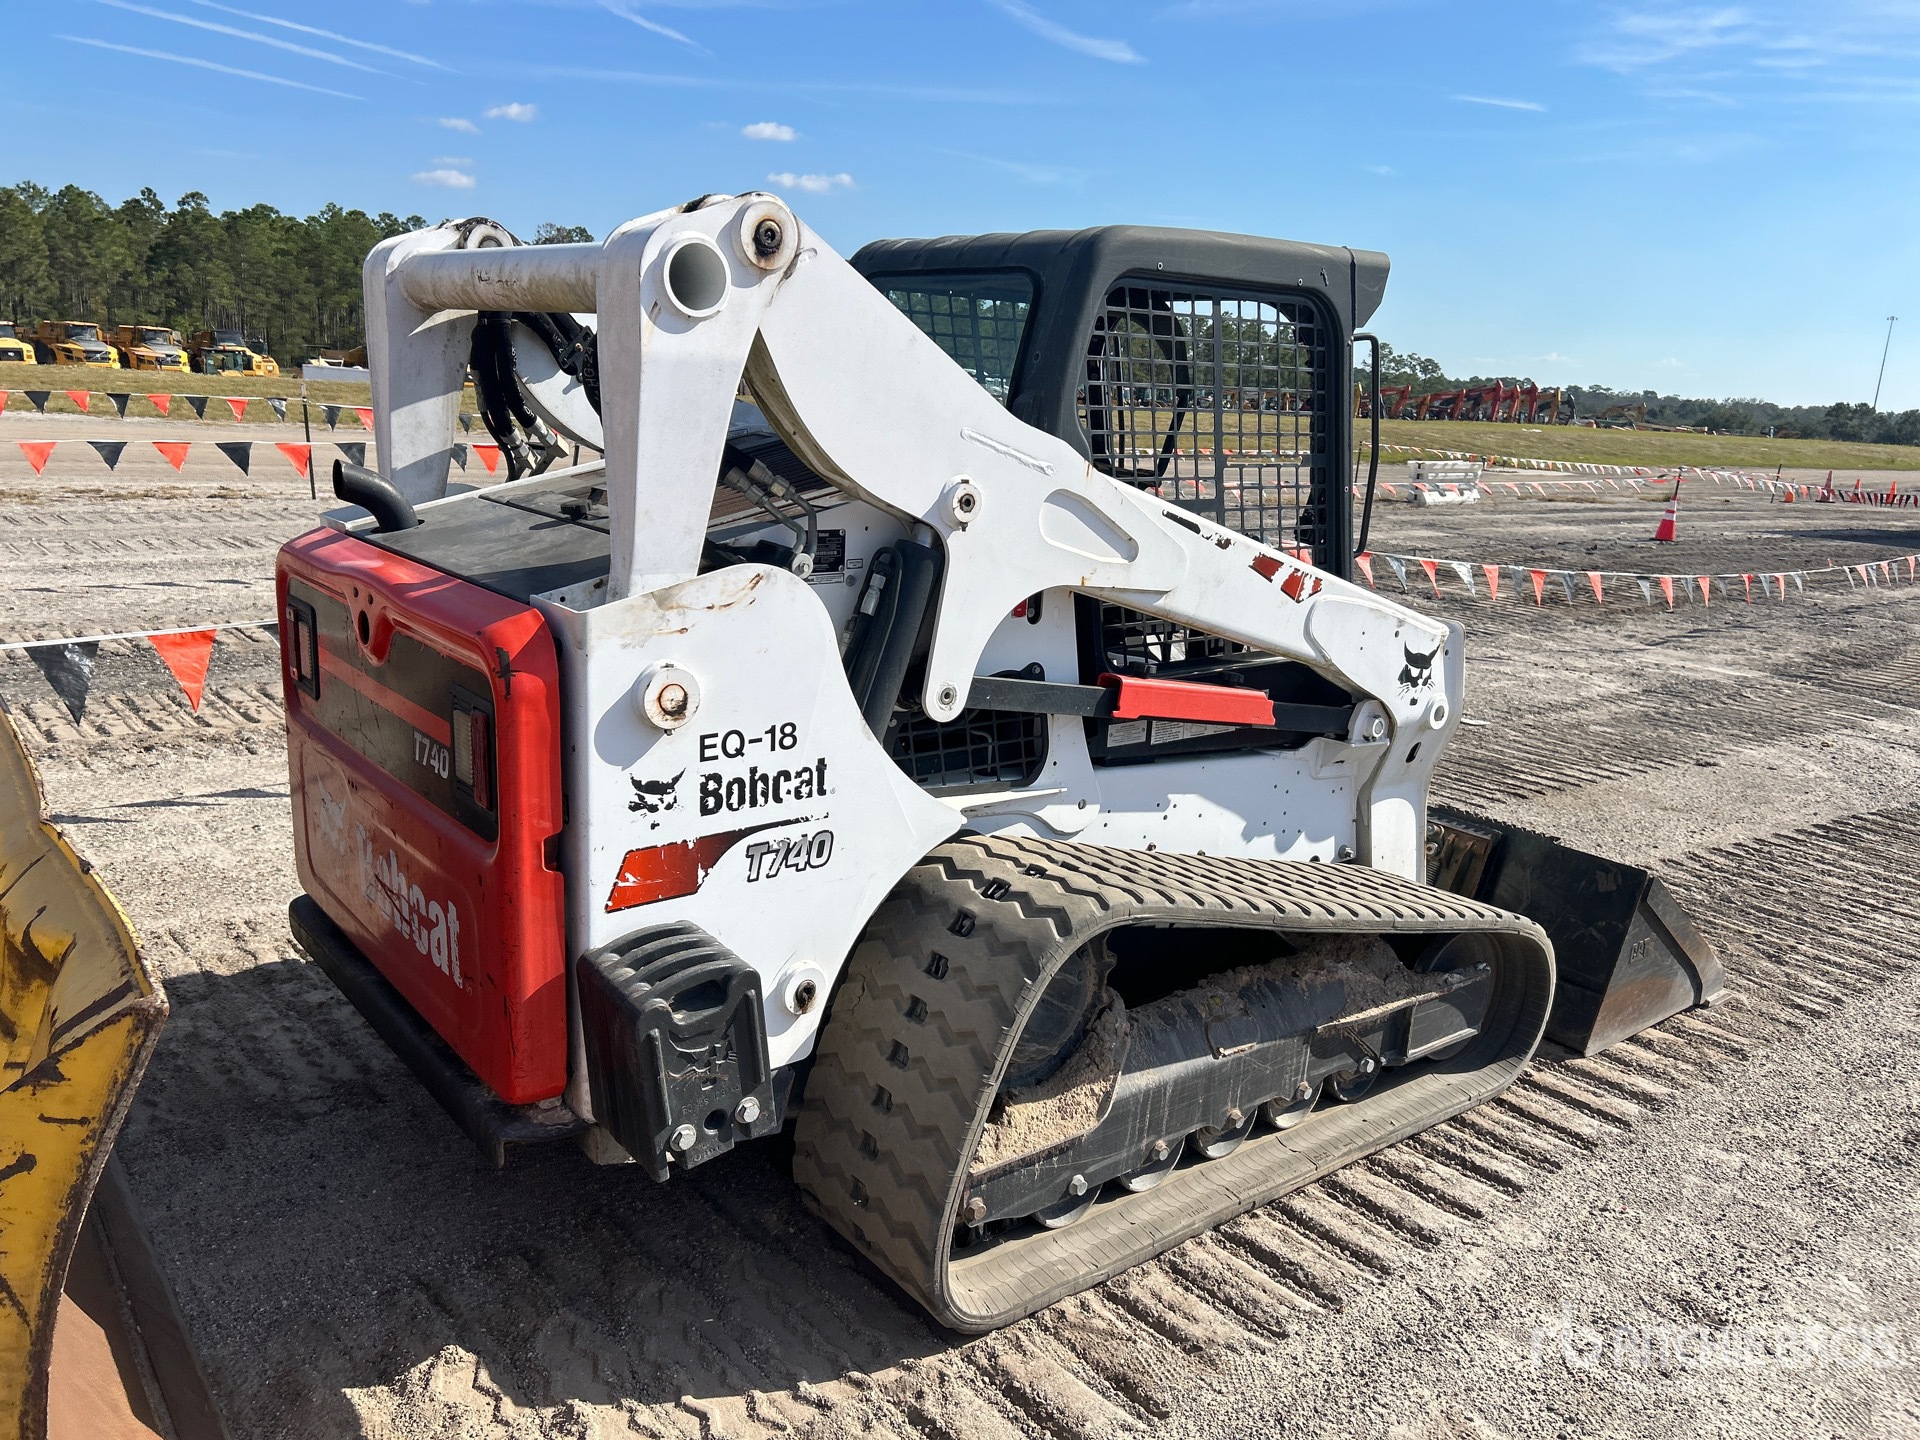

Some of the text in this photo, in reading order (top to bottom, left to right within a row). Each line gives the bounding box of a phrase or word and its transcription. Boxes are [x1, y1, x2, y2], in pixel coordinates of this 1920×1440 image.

[413, 731, 450, 779] T740
[699, 721, 798, 763] EQ-18
[699, 757, 827, 816] Bobcat
[746, 830, 834, 883] T740
